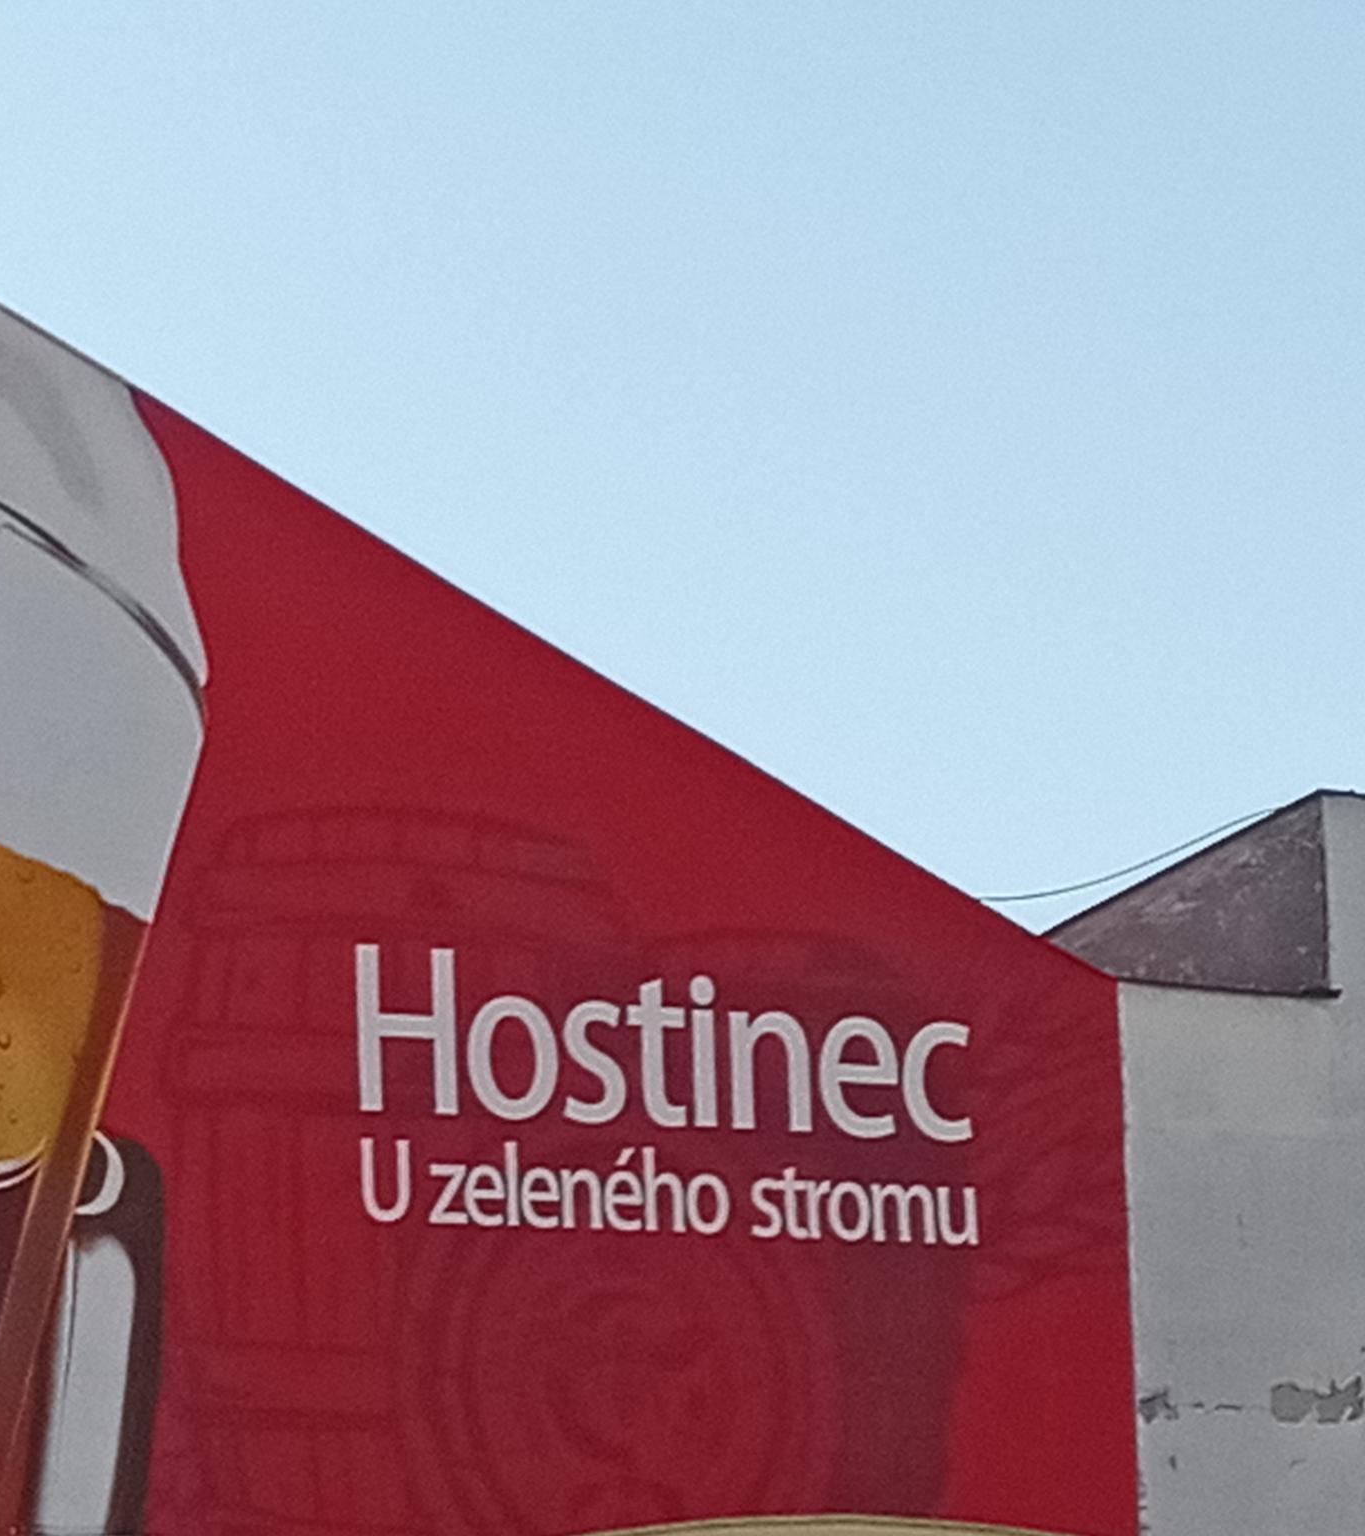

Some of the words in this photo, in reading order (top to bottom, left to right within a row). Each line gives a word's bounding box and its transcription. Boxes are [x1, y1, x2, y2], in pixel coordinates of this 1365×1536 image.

[354, 943, 973, 1141] Hostinec
[360, 1138, 412, 1222] U
[428, 1142, 730, 1236] zeleného
[750, 1166, 979, 1246] stromu
